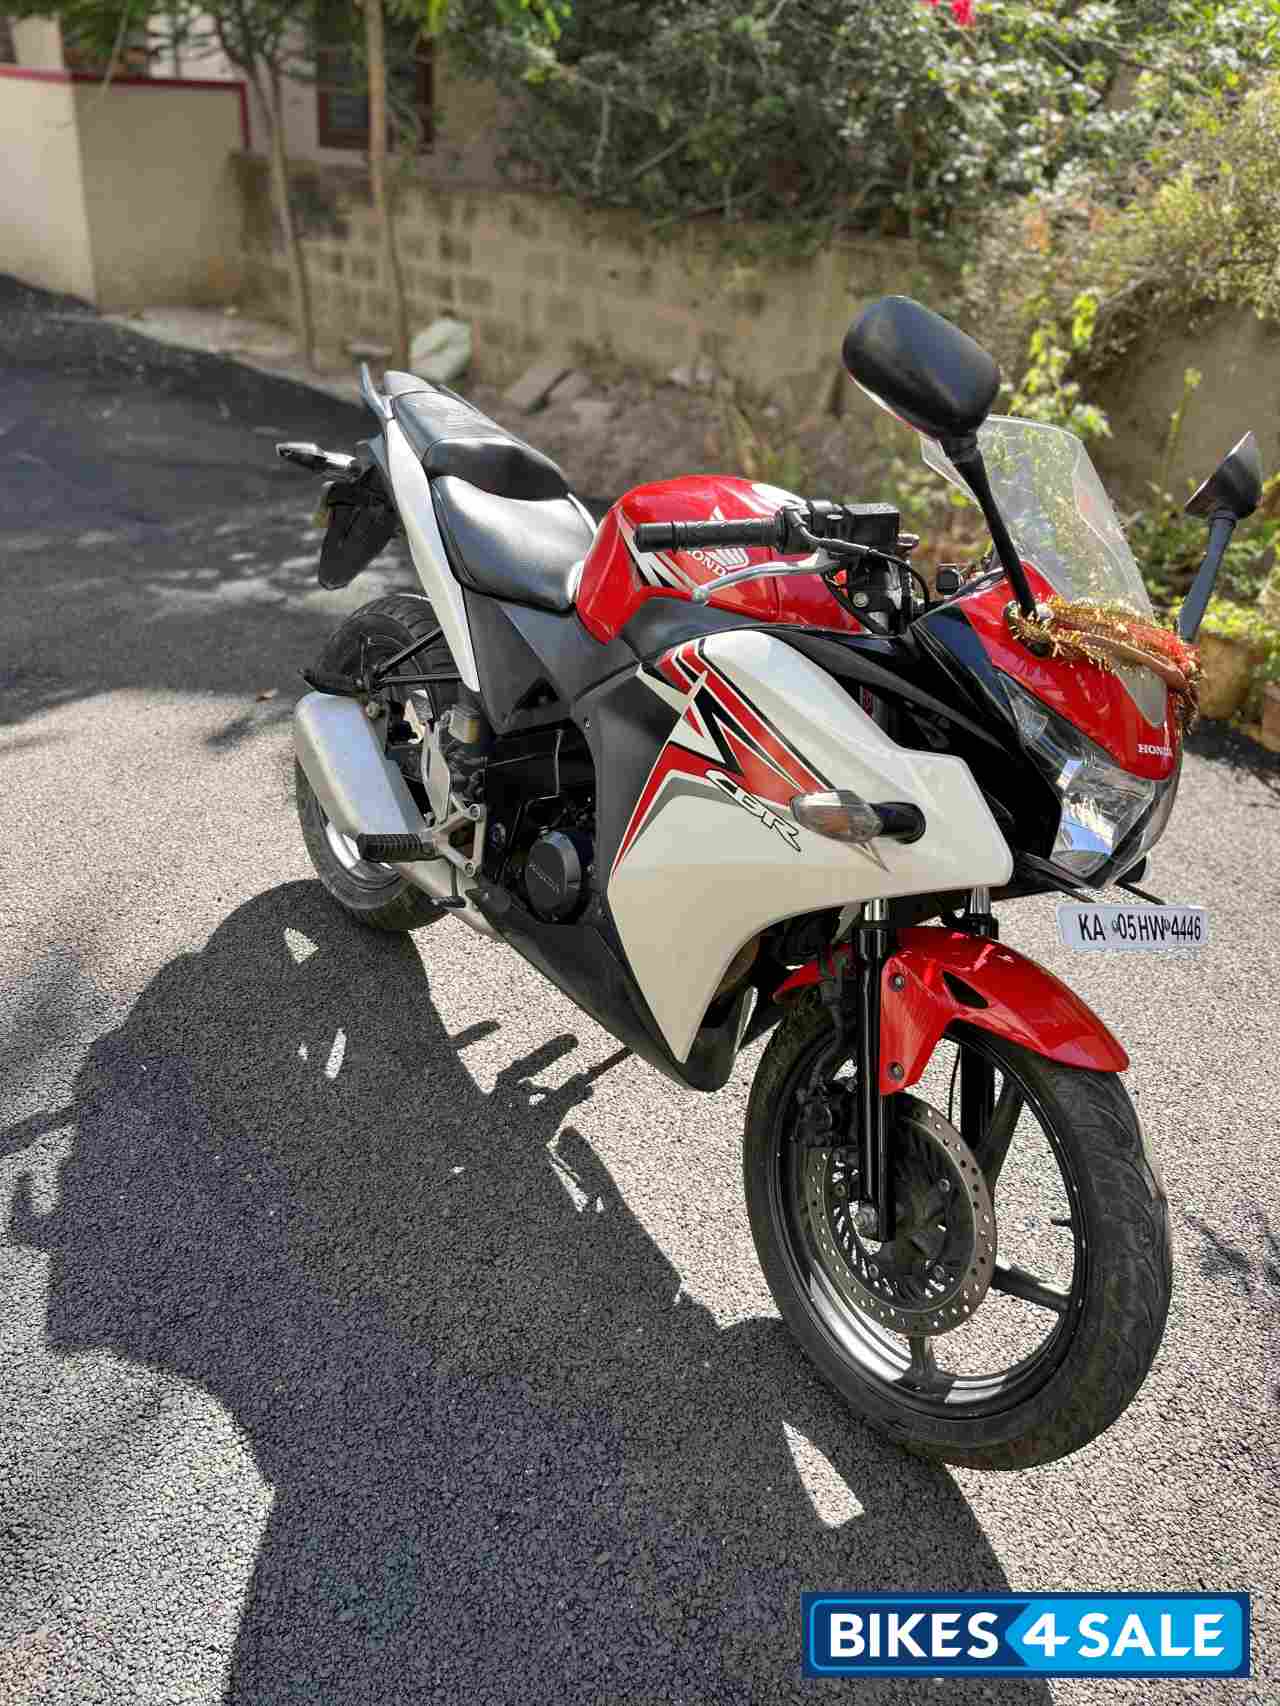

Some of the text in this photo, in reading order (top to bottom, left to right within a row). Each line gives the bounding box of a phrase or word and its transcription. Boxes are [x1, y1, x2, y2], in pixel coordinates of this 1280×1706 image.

[687, 549, 729, 576] OND
[704, 768, 801, 852] CBR
[1078, 913, 1106, 941] KA
